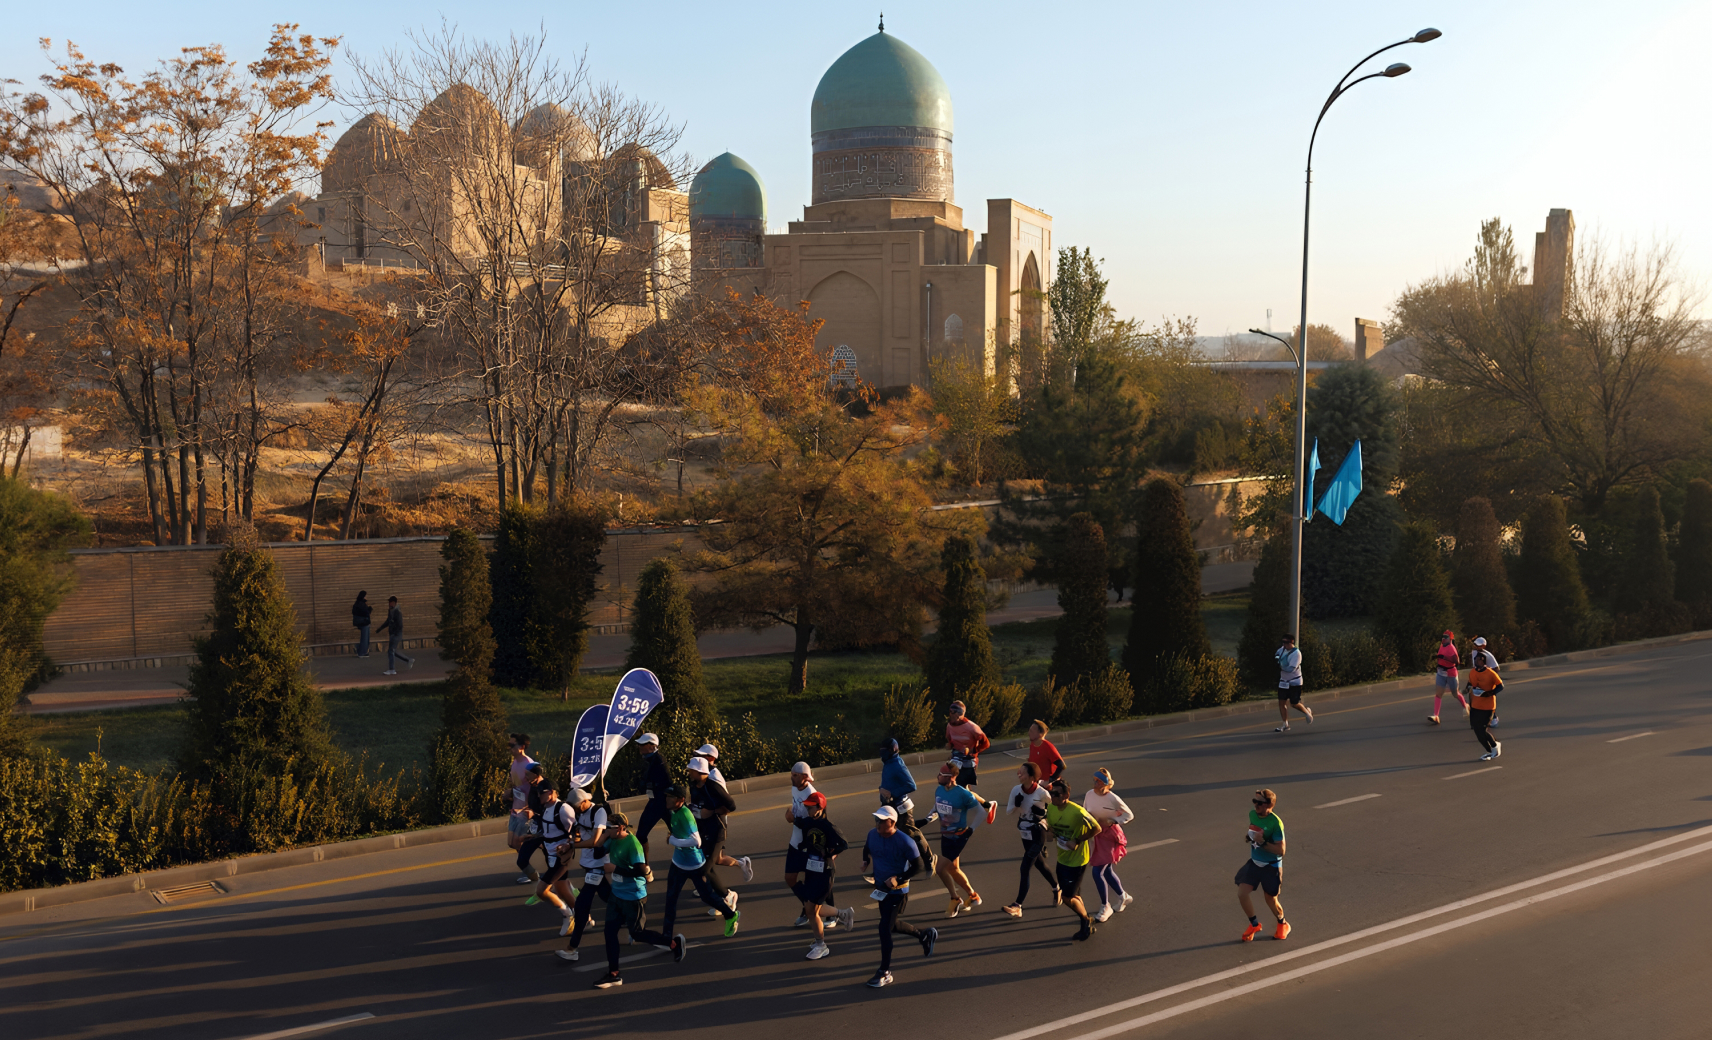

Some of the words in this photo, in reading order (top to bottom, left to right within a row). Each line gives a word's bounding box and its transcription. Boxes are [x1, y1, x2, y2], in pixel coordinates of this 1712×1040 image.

[618, 695, 649, 714] 3:59
[614, 715, 636, 727] 42.2K
[580, 736, 603, 751] 3:5
